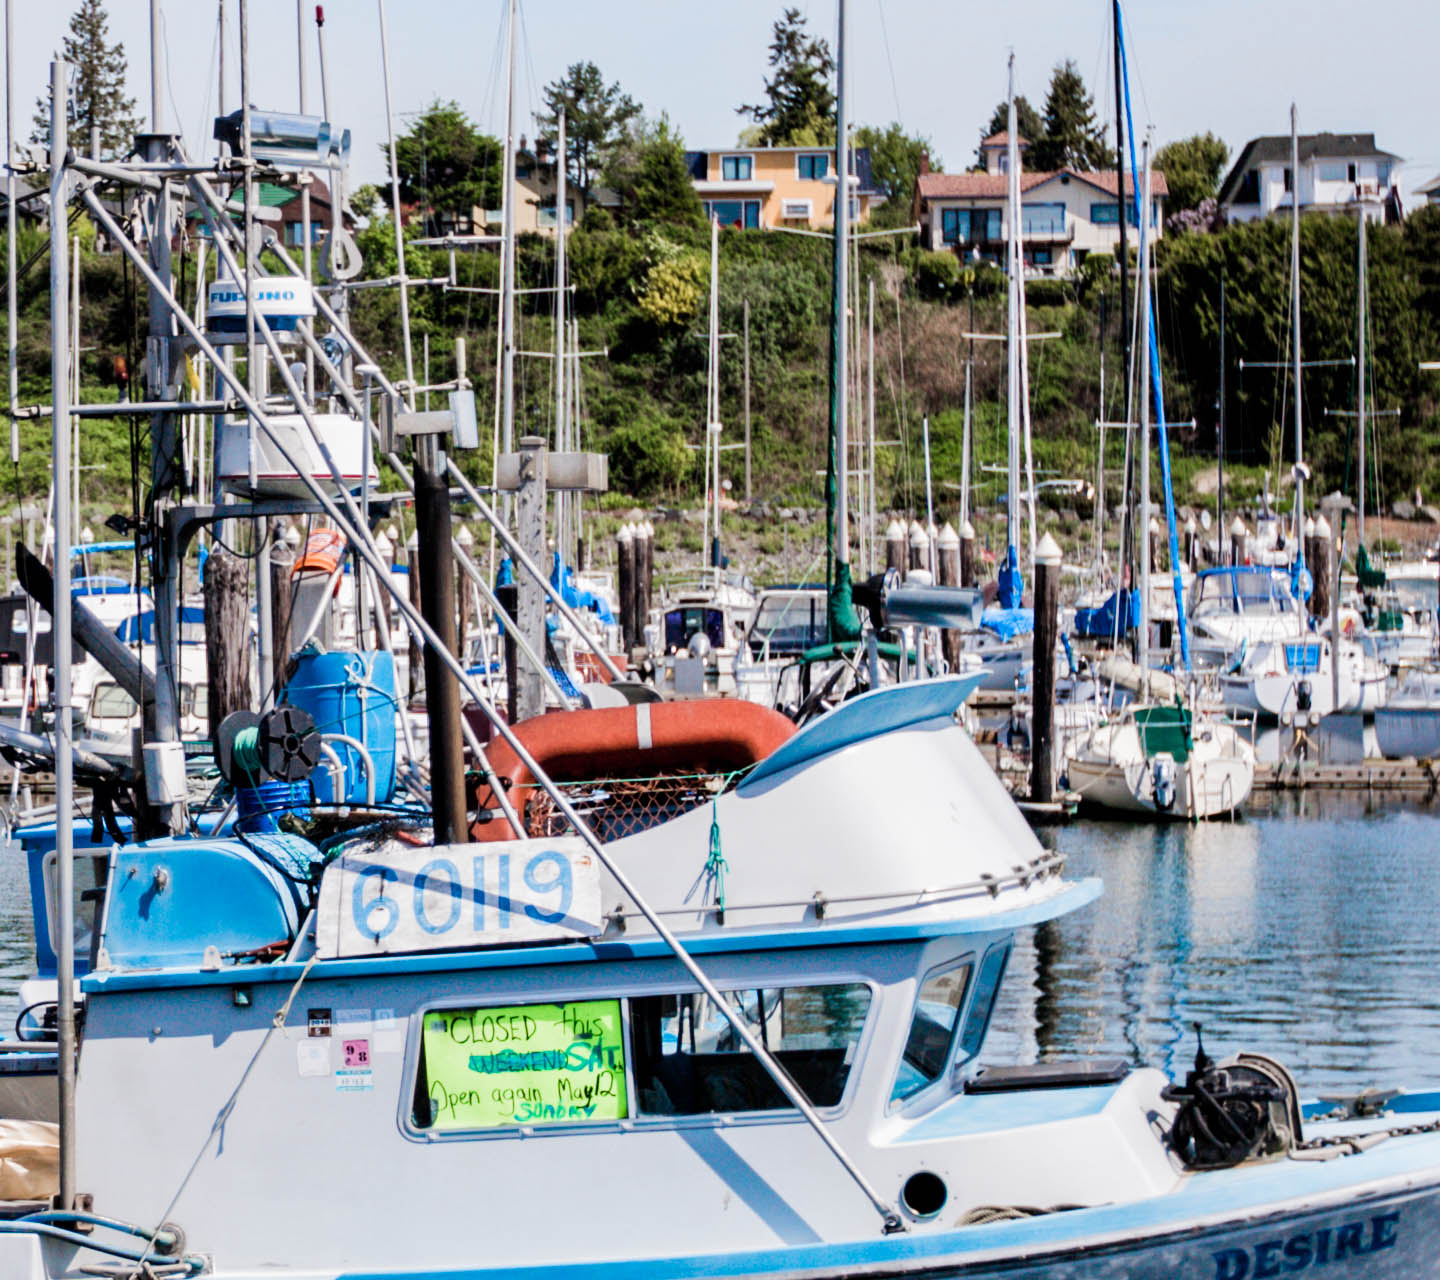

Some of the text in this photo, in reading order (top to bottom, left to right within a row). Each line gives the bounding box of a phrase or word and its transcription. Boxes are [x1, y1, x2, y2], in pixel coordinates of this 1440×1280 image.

[351, 850, 573, 940] 60119
[450, 1007, 604, 1045] CLOSED this
[430, 1080, 480, 1120] Open
[491, 1086, 543, 1116] again
